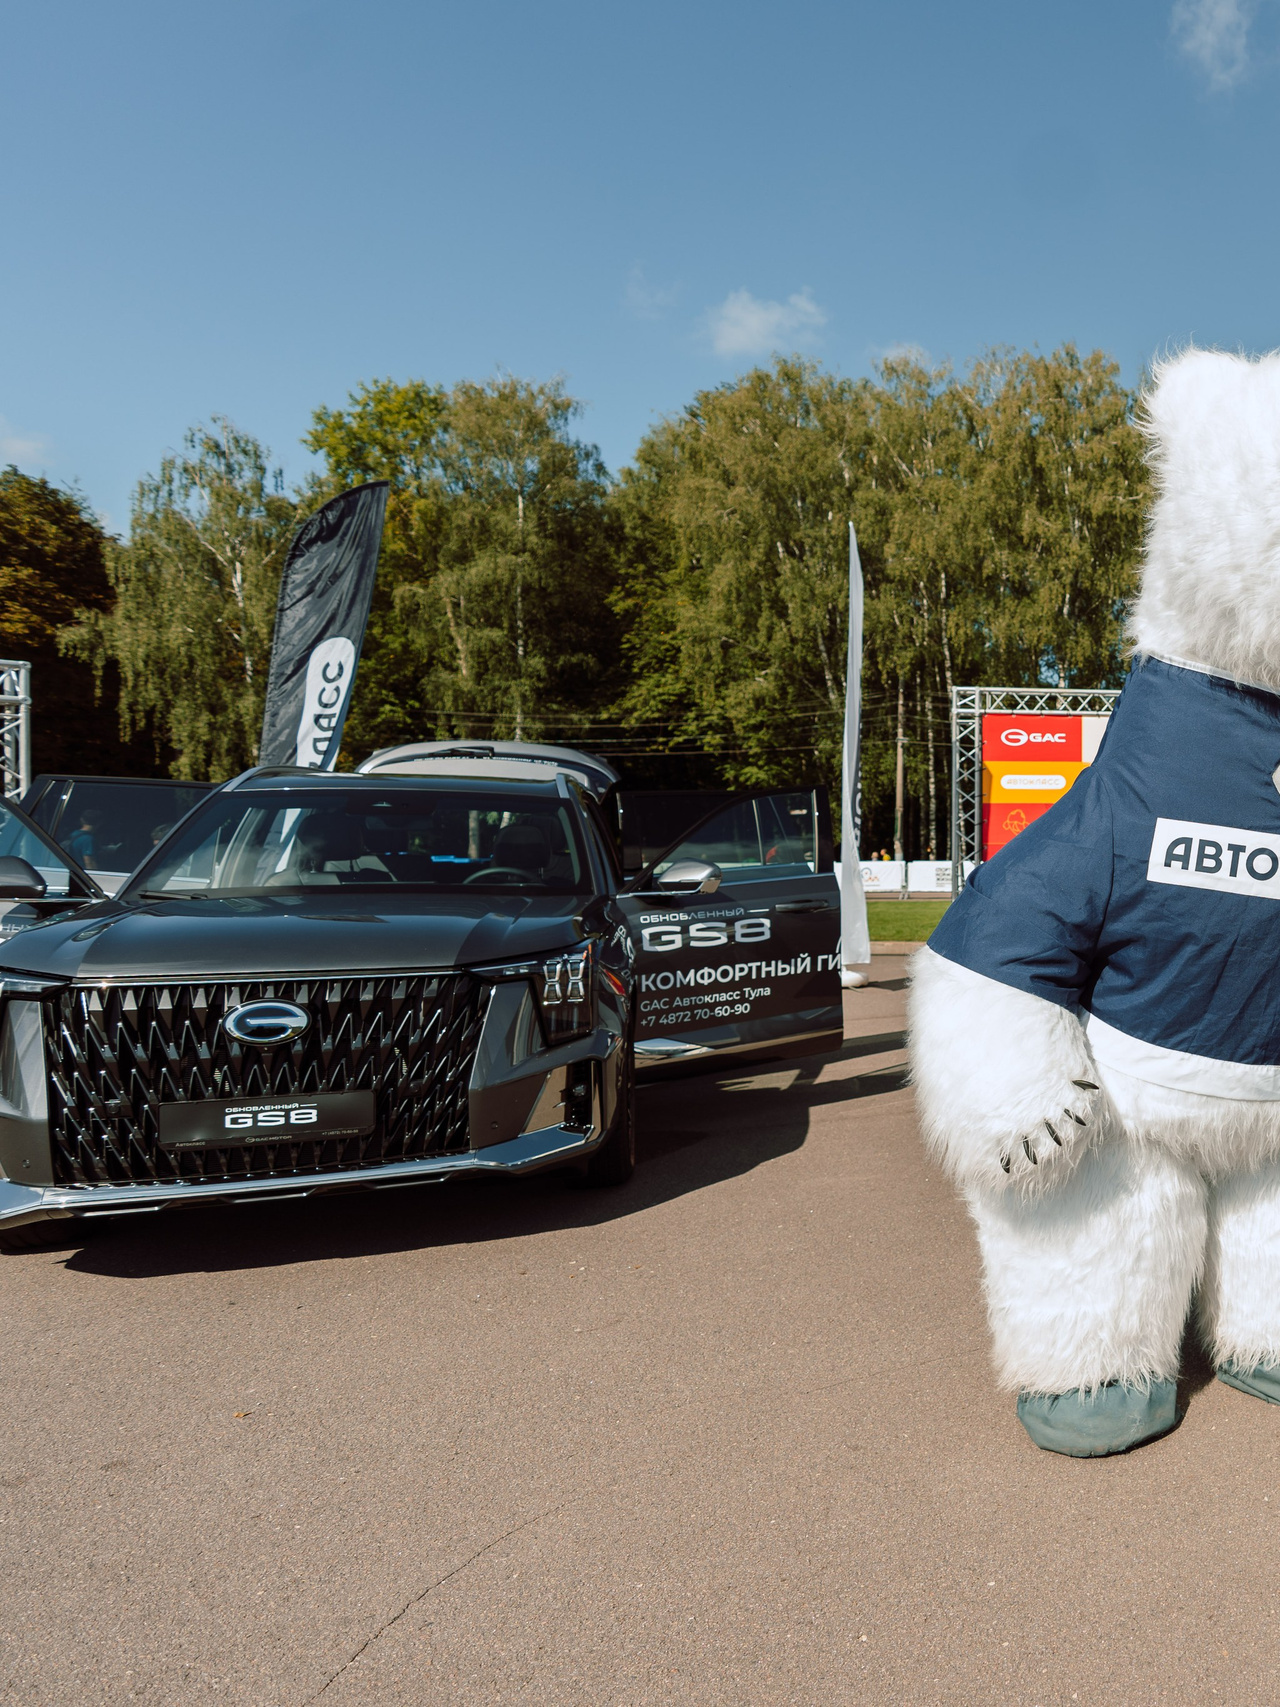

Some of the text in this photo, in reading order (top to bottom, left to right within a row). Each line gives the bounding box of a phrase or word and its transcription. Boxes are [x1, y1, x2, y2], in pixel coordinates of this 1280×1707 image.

[1029, 733, 1066, 742] GAC
[1006, 778, 1061, 786] АВТОКЛАСС
[640, 907, 744, 923] ОБНОВЛЕННЫЙ
[641, 918, 771, 952] GS8
[641, 953, 811, 992] КОМФОРТНЫЙ
[640, 986, 771, 1012] GAC Автокласс Тула
[640, 1003, 750, 1028] +7 4872 70-60-90
[225, 1103, 299, 1113] ОБНОВЛЕННЫЙ
[224, 1109, 317, 1129] GS8
